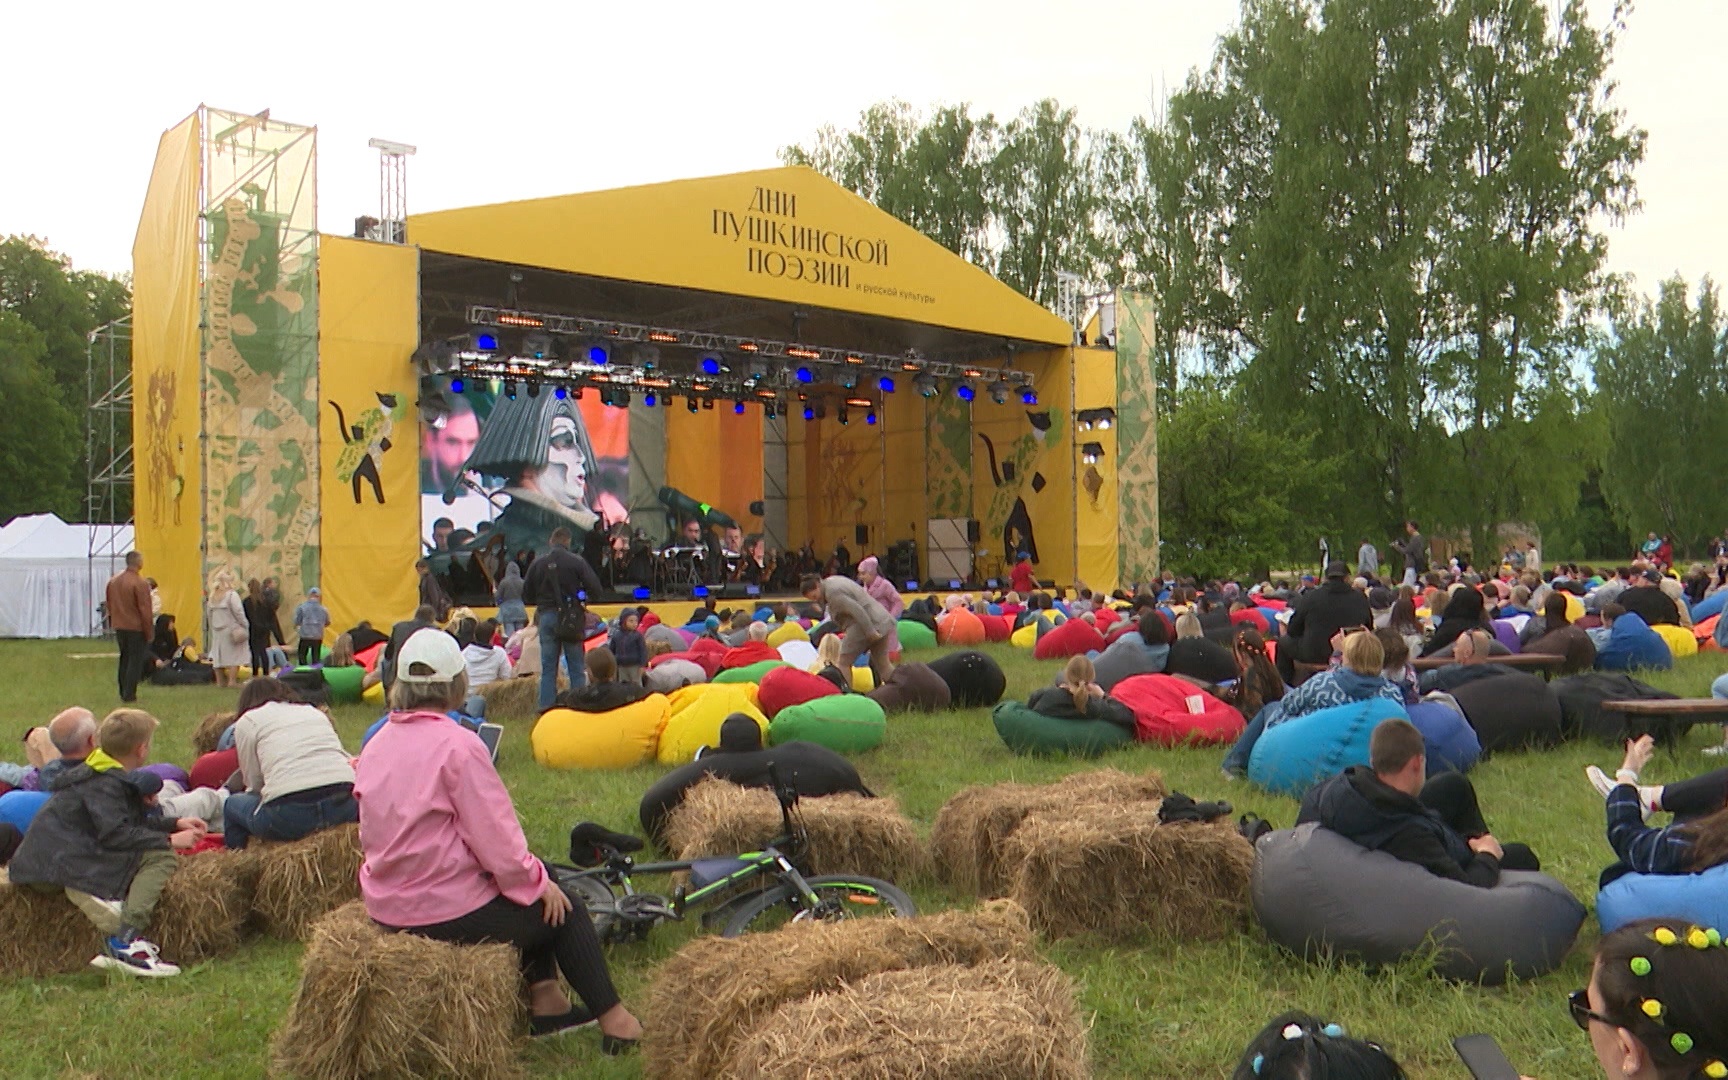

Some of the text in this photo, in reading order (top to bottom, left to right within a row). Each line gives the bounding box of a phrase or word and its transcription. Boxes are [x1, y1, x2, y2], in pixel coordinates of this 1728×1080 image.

[748, 186, 797, 218] ДНИ
[712, 208, 889, 267] ПУШКИНСКОЙ
[748, 247, 850, 288] ПОЭЗИИ
[855, 283, 936, 304] и русской культуры
